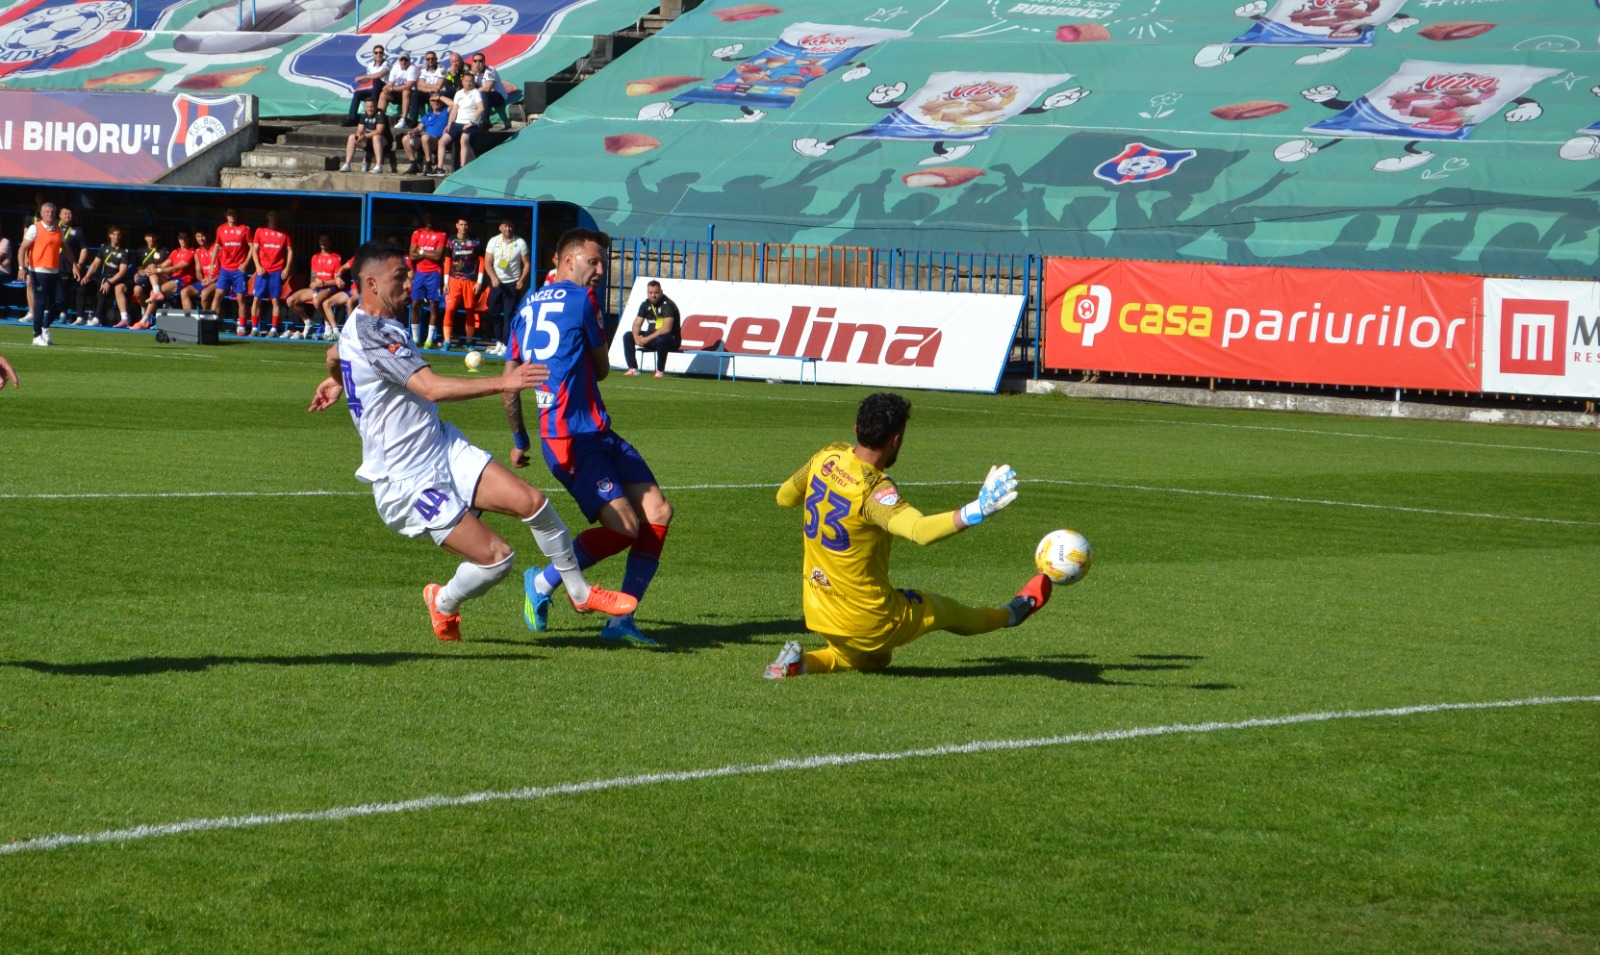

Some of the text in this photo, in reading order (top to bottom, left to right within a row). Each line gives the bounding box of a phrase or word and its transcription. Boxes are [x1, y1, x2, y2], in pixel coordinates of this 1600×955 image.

[1422, 75, 1498, 91] Viva
[680, 305, 943, 368] selina
[1119, 302, 1213, 338] casa
[1221, 302, 1466, 349] pariurilor
[413, 488, 450, 522] 44
[804, 474, 852, 552] 33
